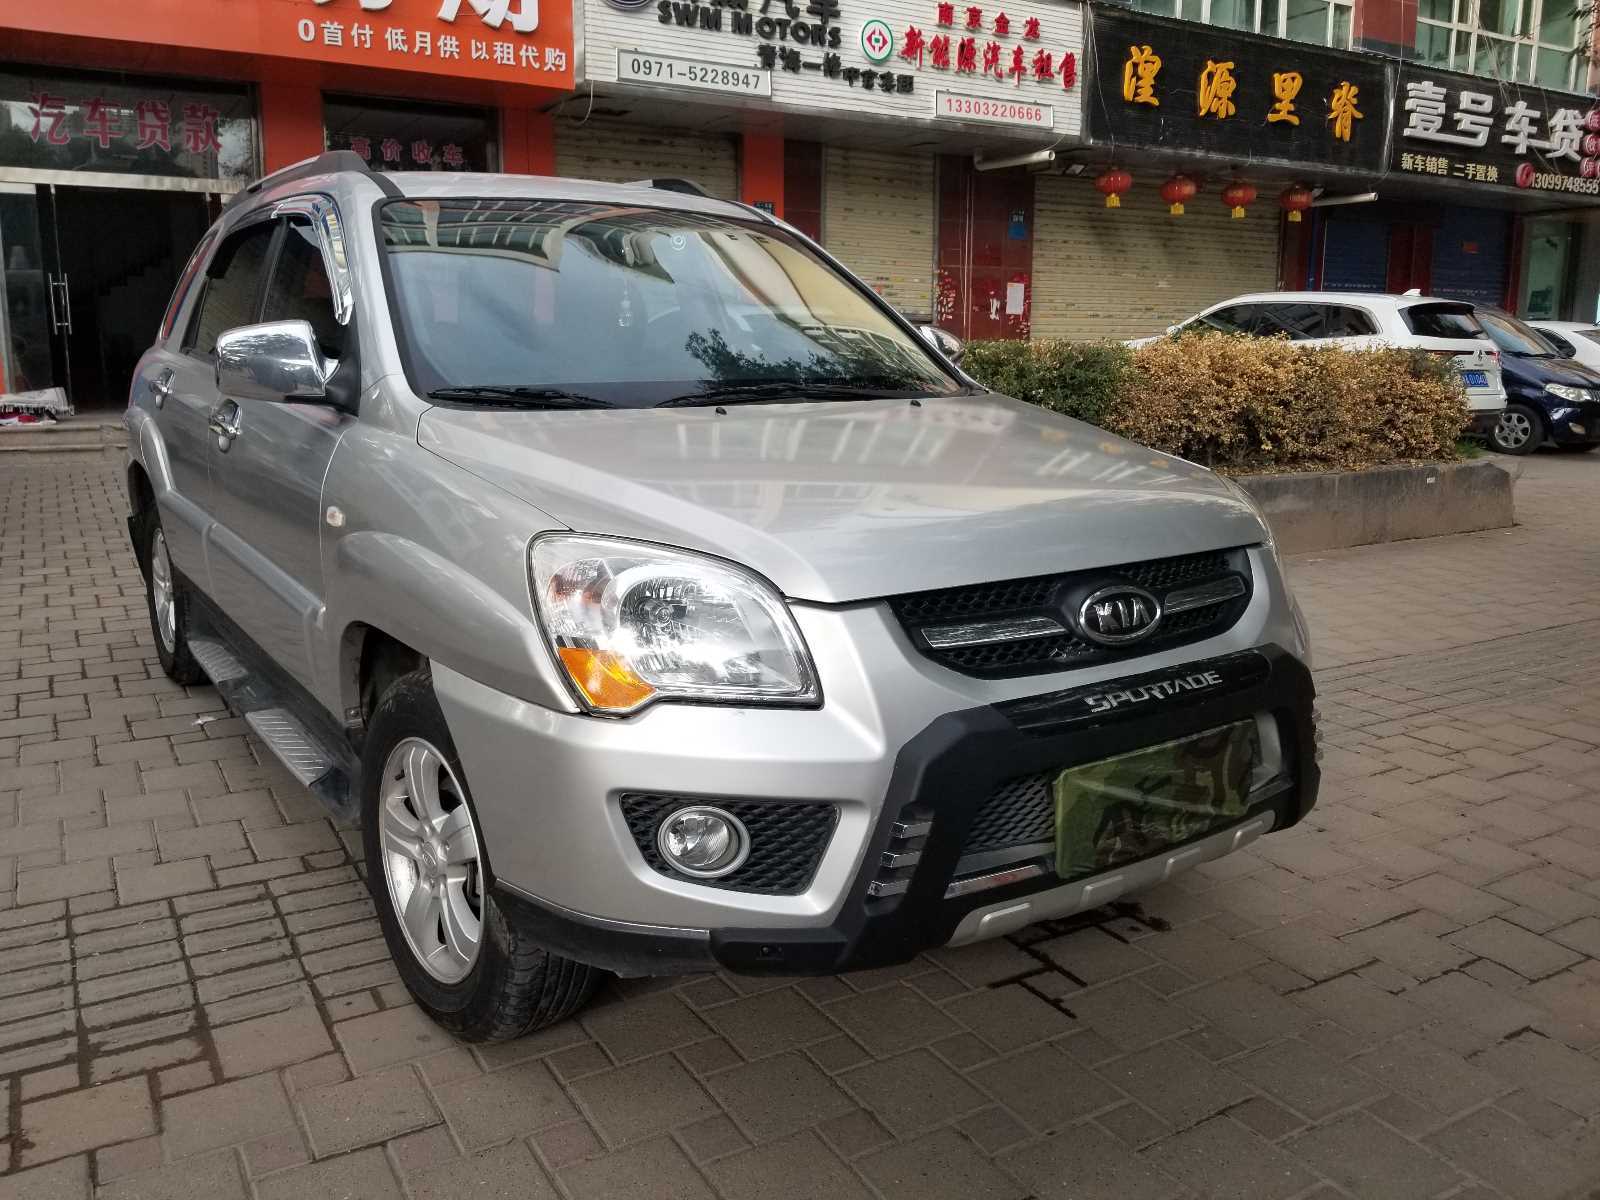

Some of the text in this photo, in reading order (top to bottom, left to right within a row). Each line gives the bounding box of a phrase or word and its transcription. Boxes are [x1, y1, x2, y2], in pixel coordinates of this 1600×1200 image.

[657, 0, 841, 48] SWM MOTORS
[937, 2, 1042, 40] 南京金龙
[298, 19, 567, 72] 0首付 低月供 以租代购
[898, 24, 1077, 90] 新能源汽车租售
[631, 58, 761, 90] 0971-5228947
[1123, 45, 1364, 142] 湟源里脊
[28, 92, 222, 153] 汽车贷款
[946, 98, 1042, 121] 13303220666
[1403, 80, 1585, 161] 壹号车贷
[1401, 153, 1499, 183] 新车销售 二手置换
[1092, 598, 1152, 633] KIA
